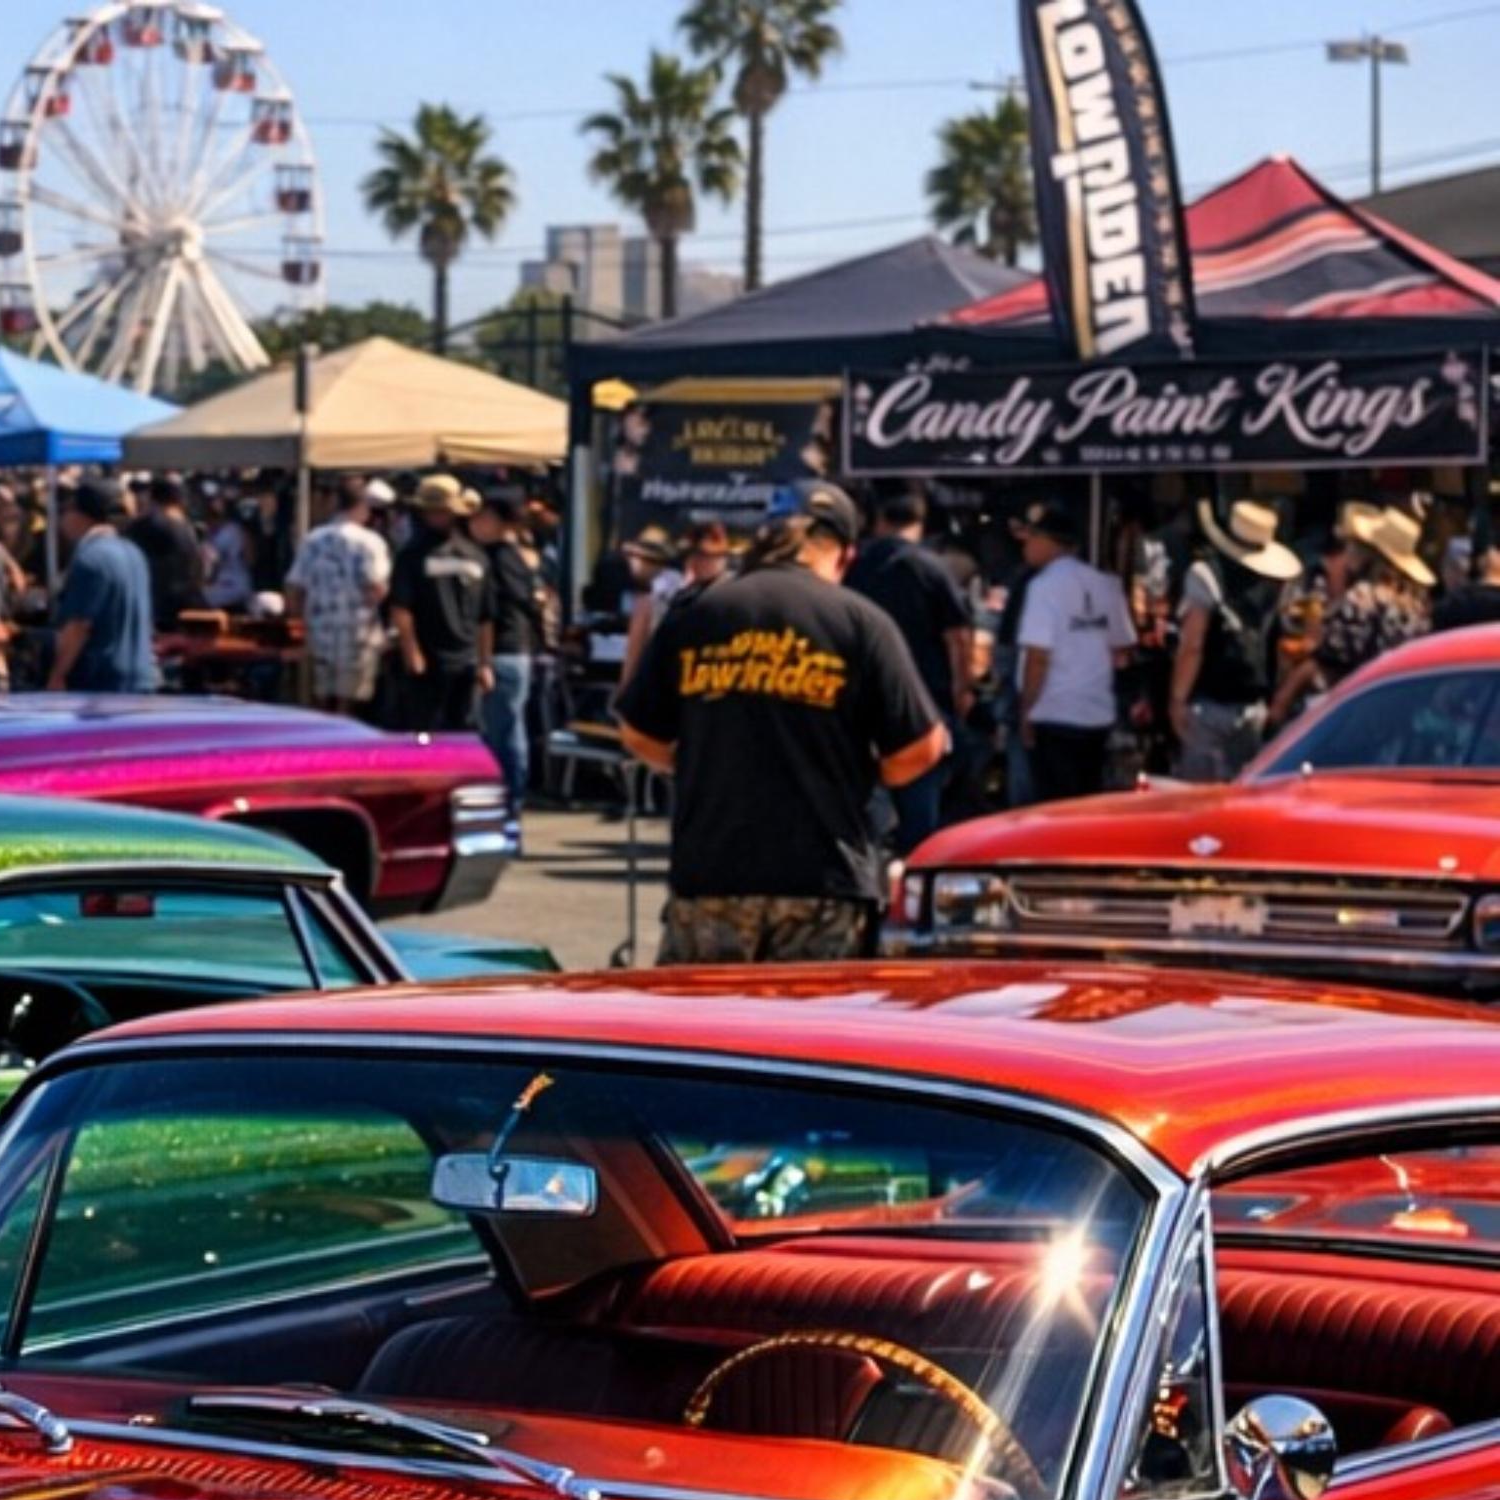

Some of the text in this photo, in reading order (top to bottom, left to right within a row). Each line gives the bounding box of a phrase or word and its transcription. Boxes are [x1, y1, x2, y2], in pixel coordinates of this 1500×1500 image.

[867, 373, 1052, 465] Candy
[1054, 366, 1241, 443] Paint
[1242, 361, 1432, 456] Kings
